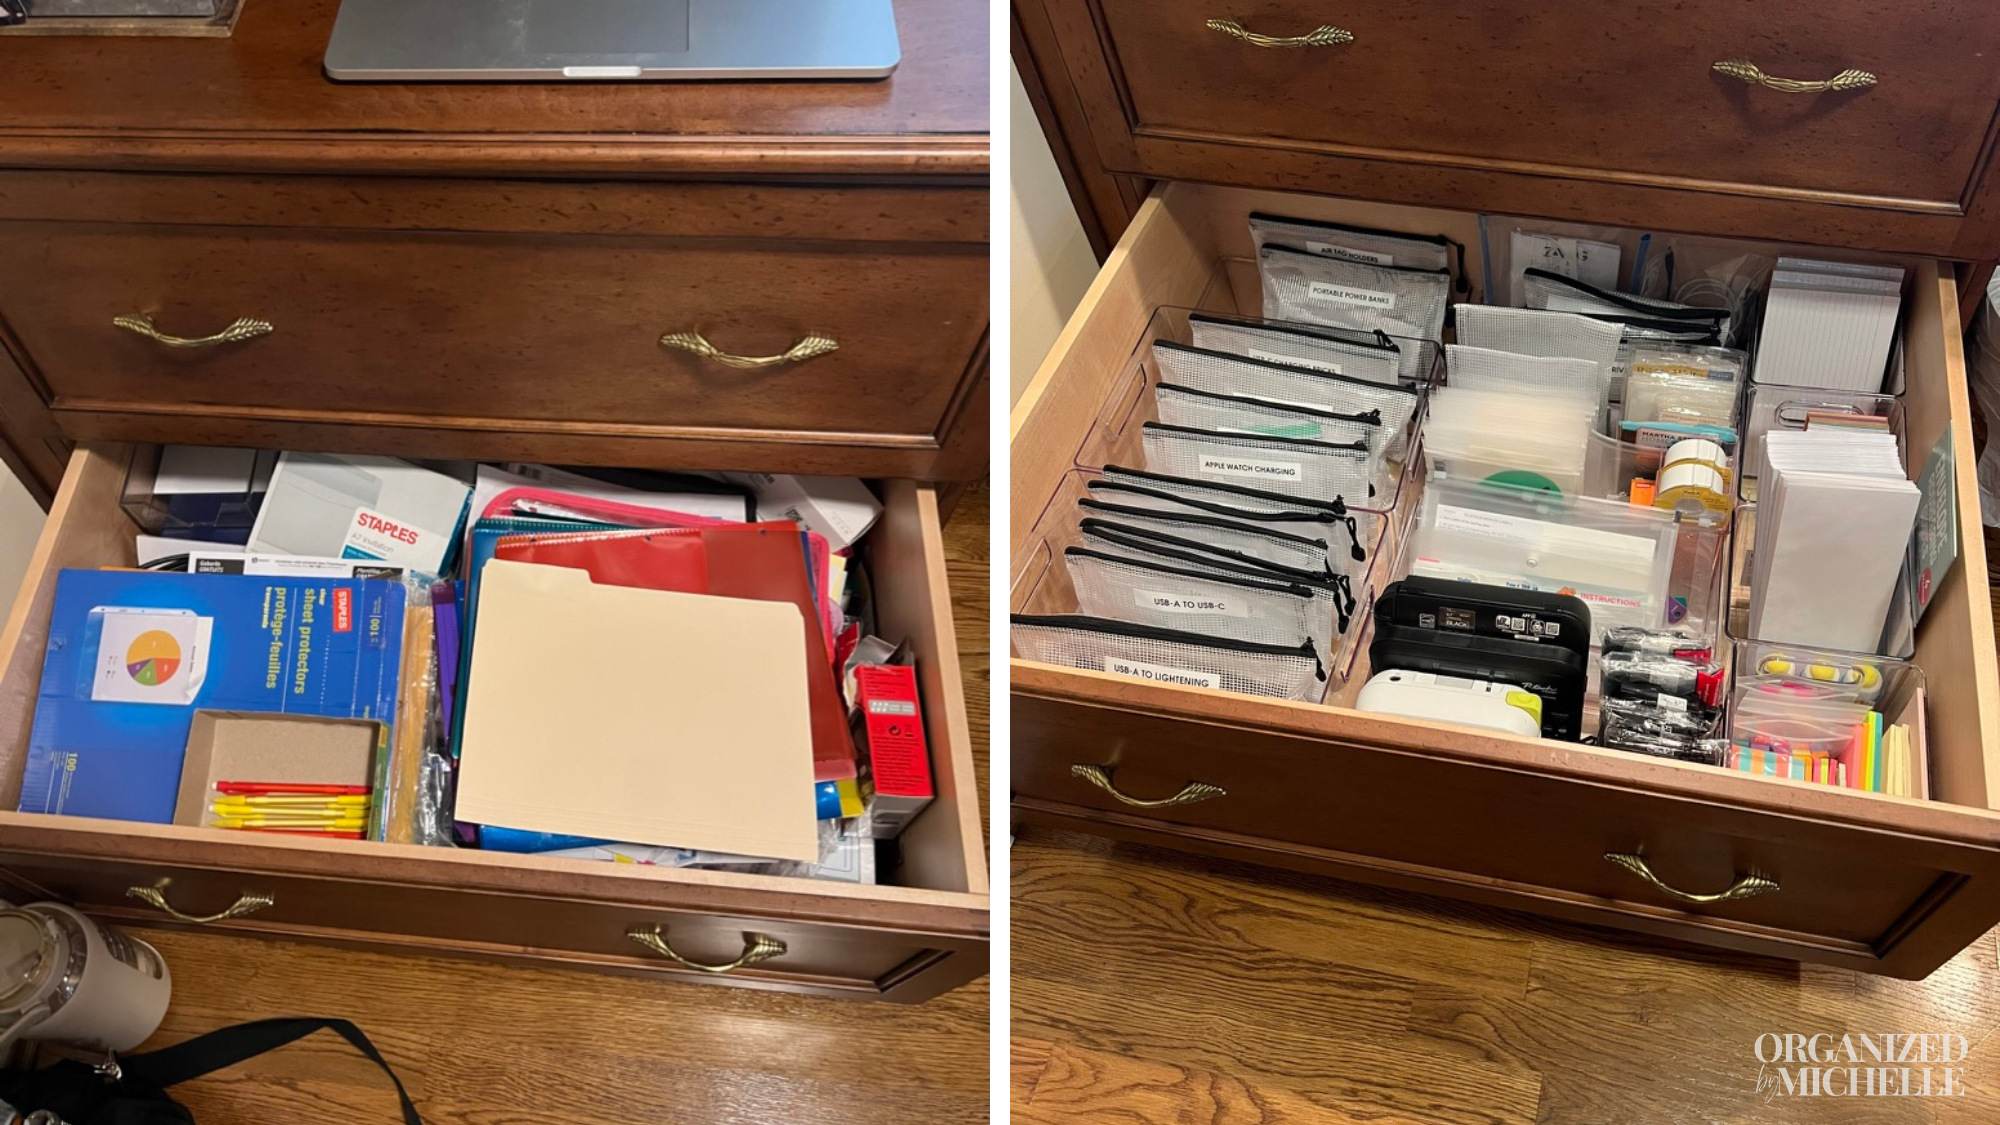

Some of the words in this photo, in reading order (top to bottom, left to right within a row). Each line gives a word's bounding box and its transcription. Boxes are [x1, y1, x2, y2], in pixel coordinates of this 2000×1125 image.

[1334, 248, 1347, 257] TAG
[1348, 253, 1379, 263] HOLDERS
[1313, 287, 1344, 298] PORTABLE
[1345, 291, 1368, 301] POWER
[1368, 295, 1390, 304] BANKS
[1205, 461, 1225, 470] APPLE
[1227, 463, 1253, 472] WATCH
[1255, 465, 1296, 476] CHARGING
[357, 512, 418, 545] STAPLES
[302, 588, 316, 623] sheet
[1154, 597, 1180, 607] USB-A
[1183, 600, 1195, 608] TO
[1197, 602, 1225, 610] USB-C
[1580, 592, 1641, 608] INSTRUCTIONS
[338, 590, 348, 630] STAPLES
[370, 618, 380, 636] 100
[1446, 620, 1469, 628] BLACK
[266, 587, 286, 689] protège-feuilles
[294, 626, 312, 694] protectors
[1113, 664, 1139, 676] USB-A
[1141, 669, 1153, 679] TO
[1155, 672, 1209, 688] LIGHTENING
[66, 753, 77, 770] 100
